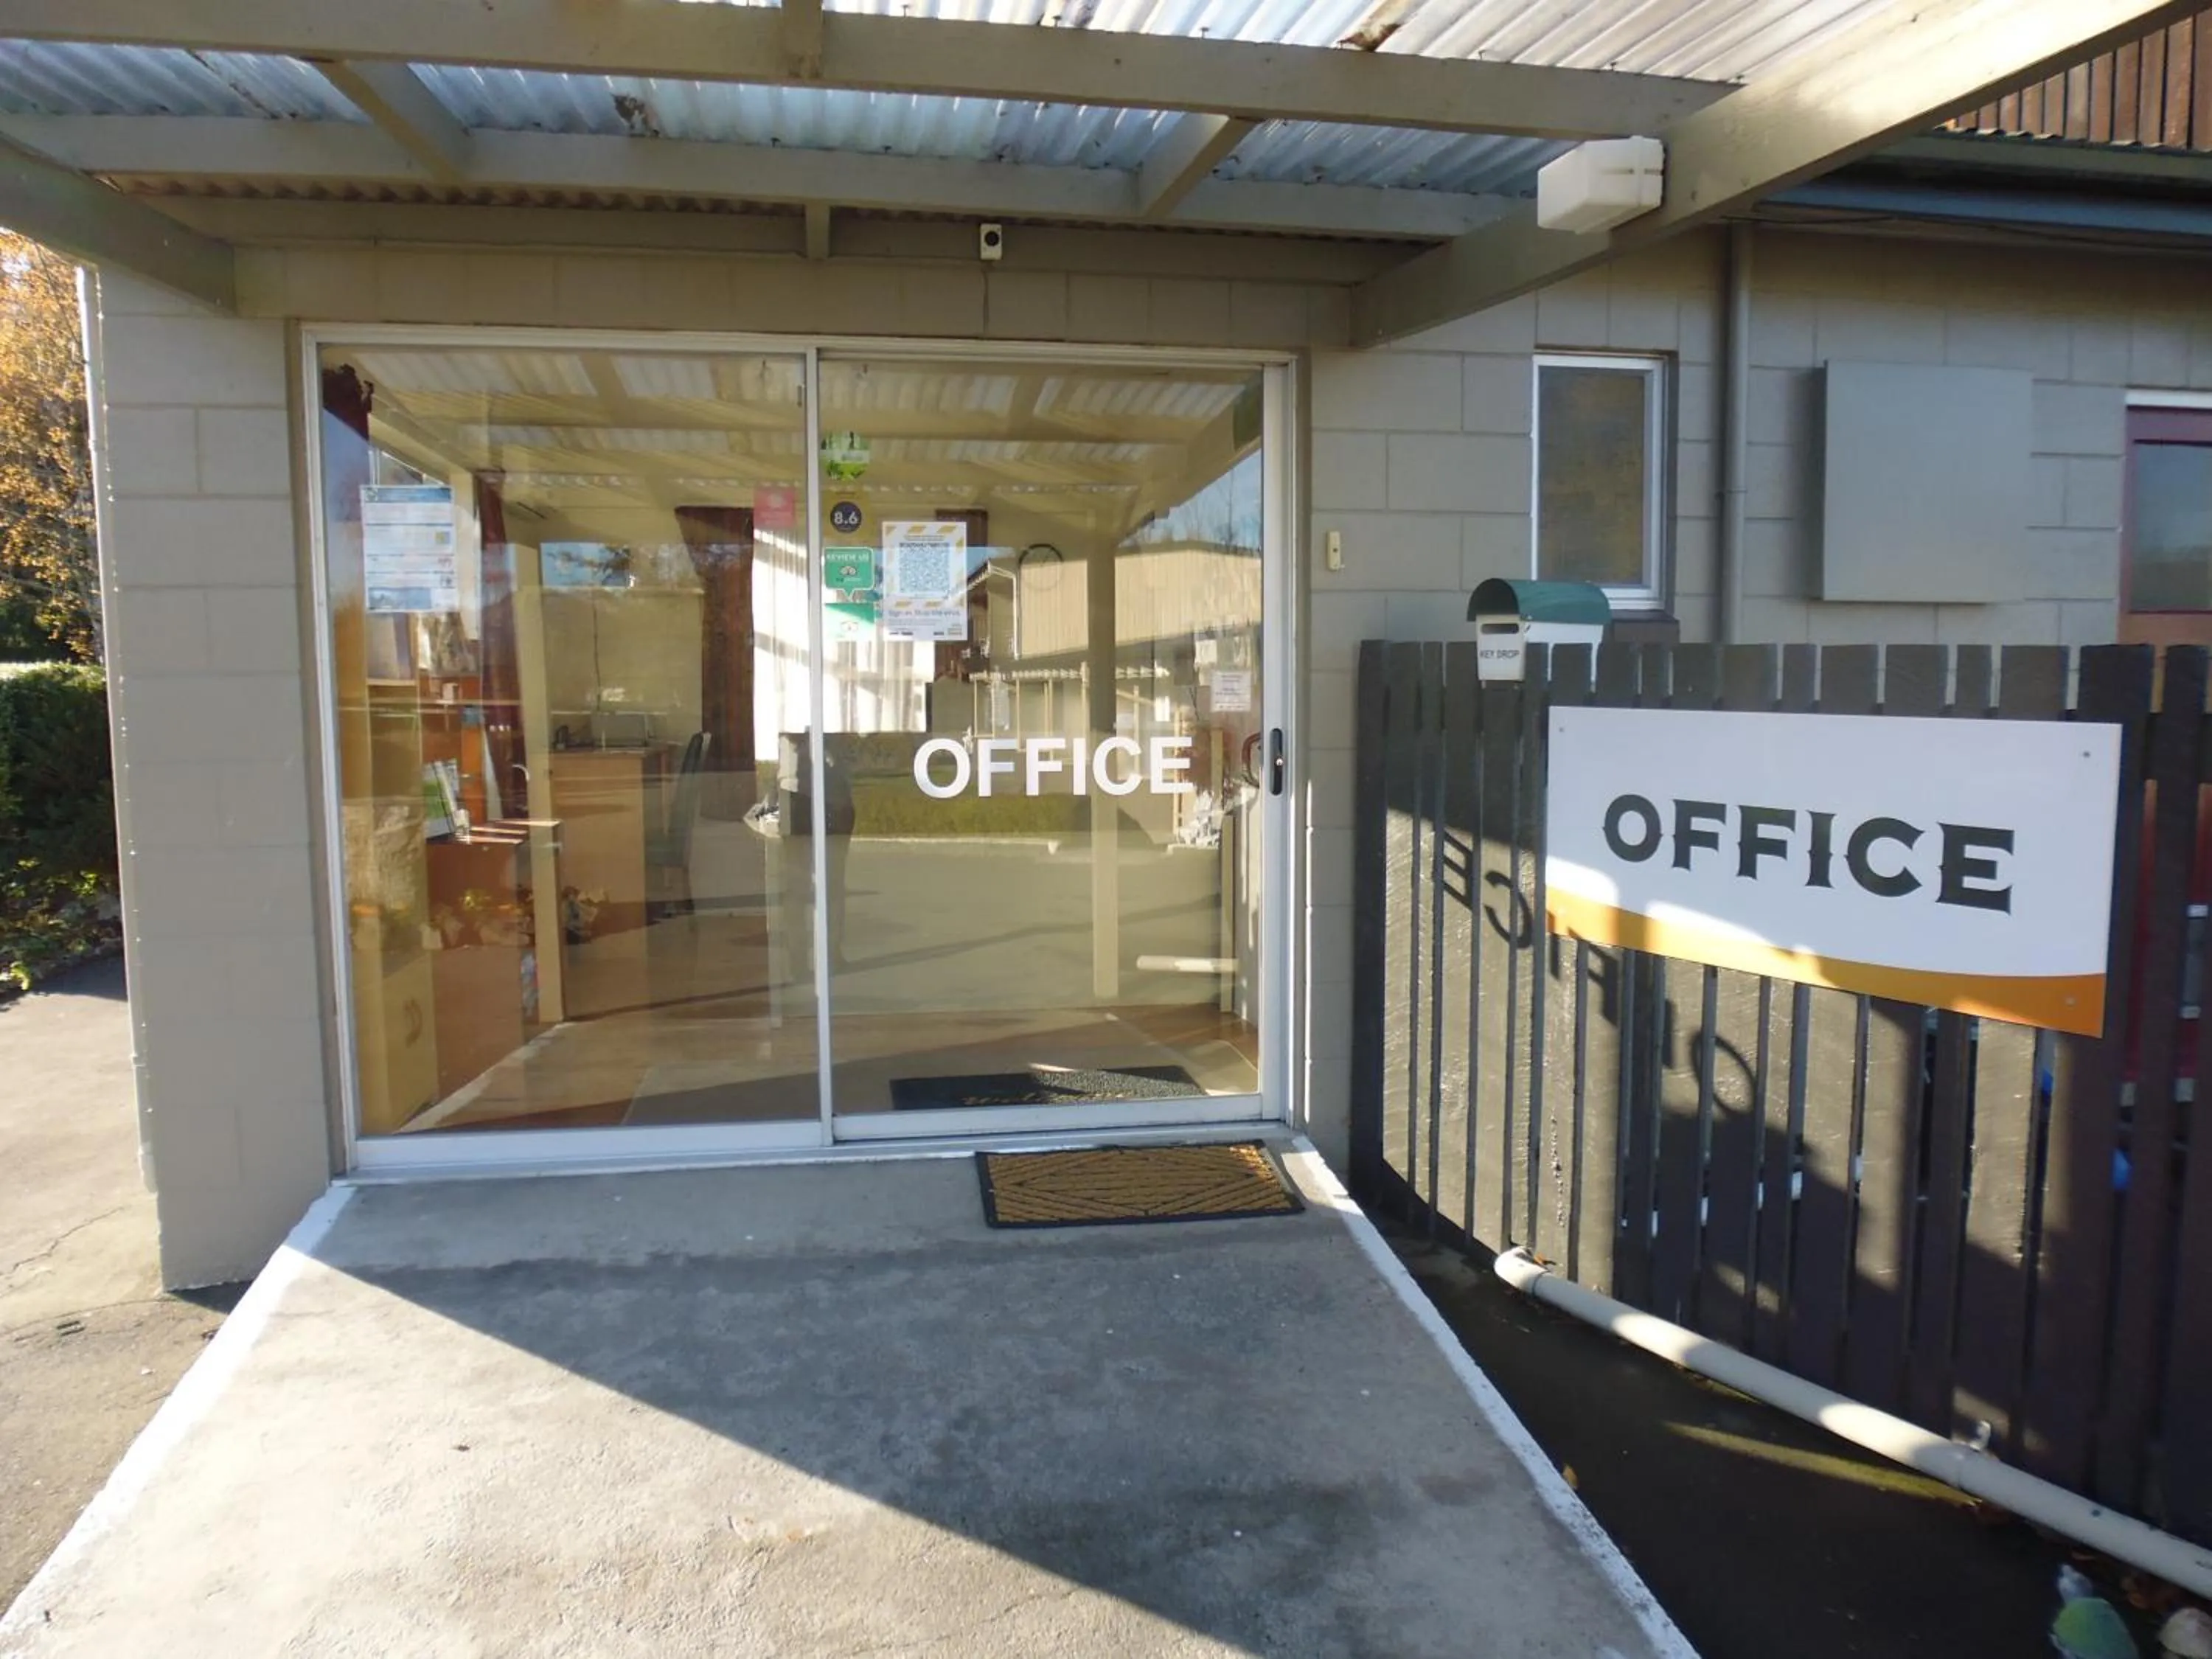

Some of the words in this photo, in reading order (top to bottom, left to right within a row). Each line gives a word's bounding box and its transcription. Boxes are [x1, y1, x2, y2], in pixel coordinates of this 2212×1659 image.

[834, 511, 858, 524] 8.6
[1479, 650, 1495, 658] KEY
[1497, 650, 1520, 659] DROP
[914, 737, 1194, 799] OFFICE
[1602, 794, 2015, 916] OFFICE
